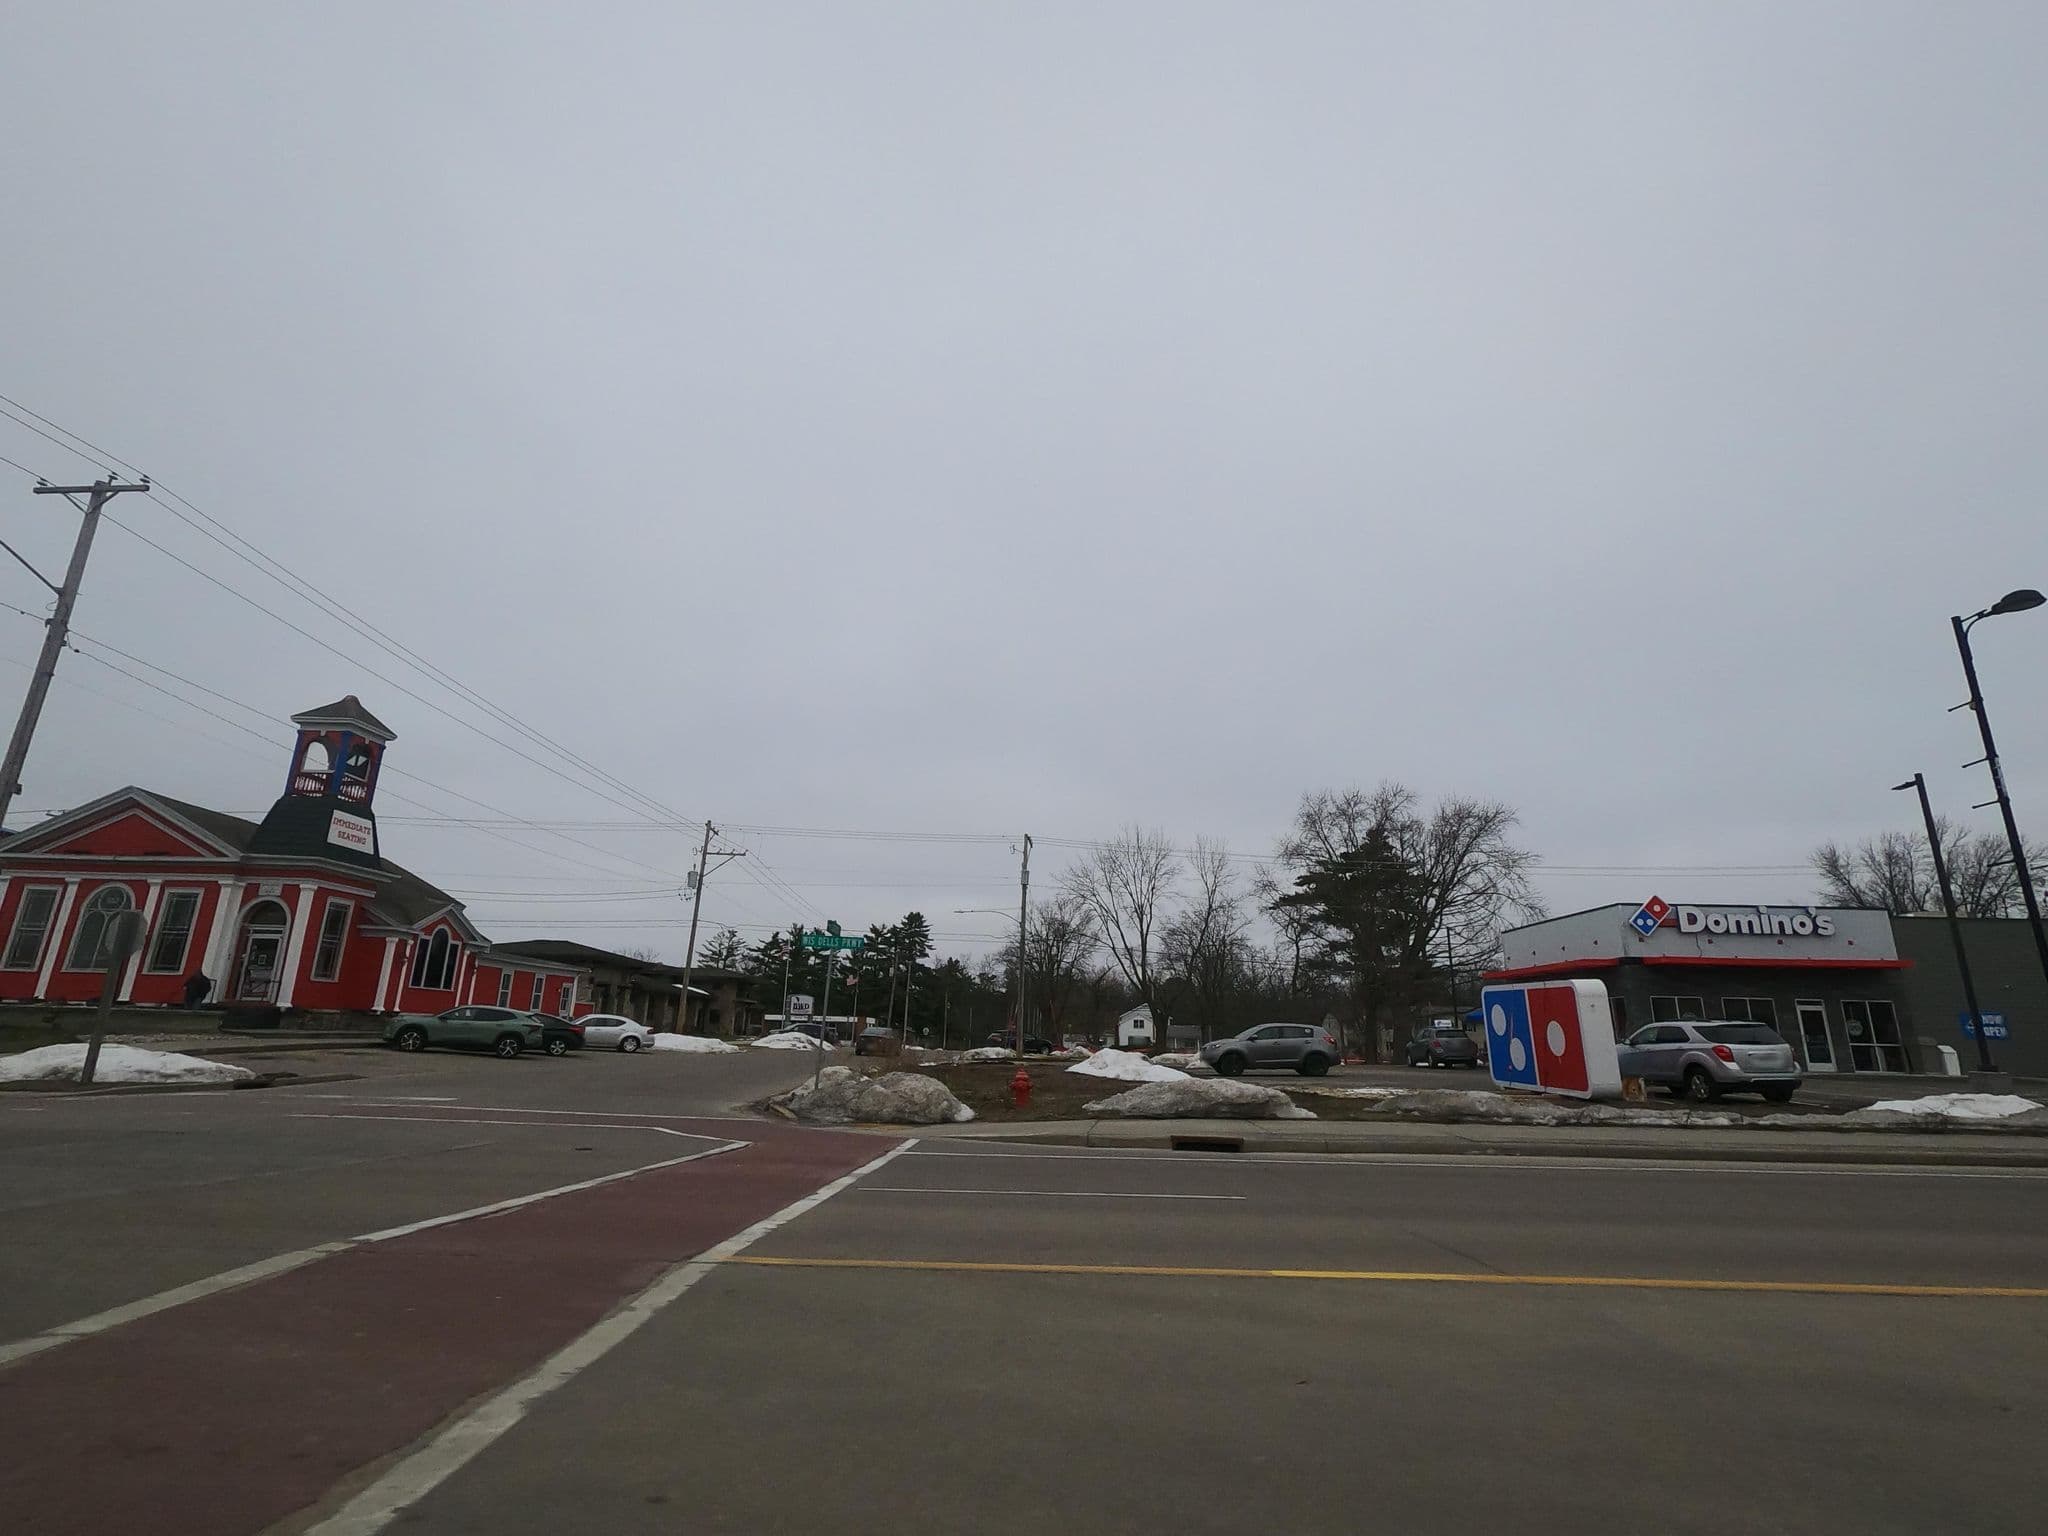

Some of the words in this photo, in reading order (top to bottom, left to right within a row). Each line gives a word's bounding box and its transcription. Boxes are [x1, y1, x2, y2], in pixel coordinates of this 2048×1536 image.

[332, 817, 372, 835] IMMEDIATE
[337, 831, 367, 845] SEATING
[1677, 905, 1836, 936] Domino's
[802, 936, 815, 946] WIS
[818, 936, 839, 946] DELLS
[842, 938, 863, 948] PKWY
[1983, 1026, 2006, 1037] OPEN
